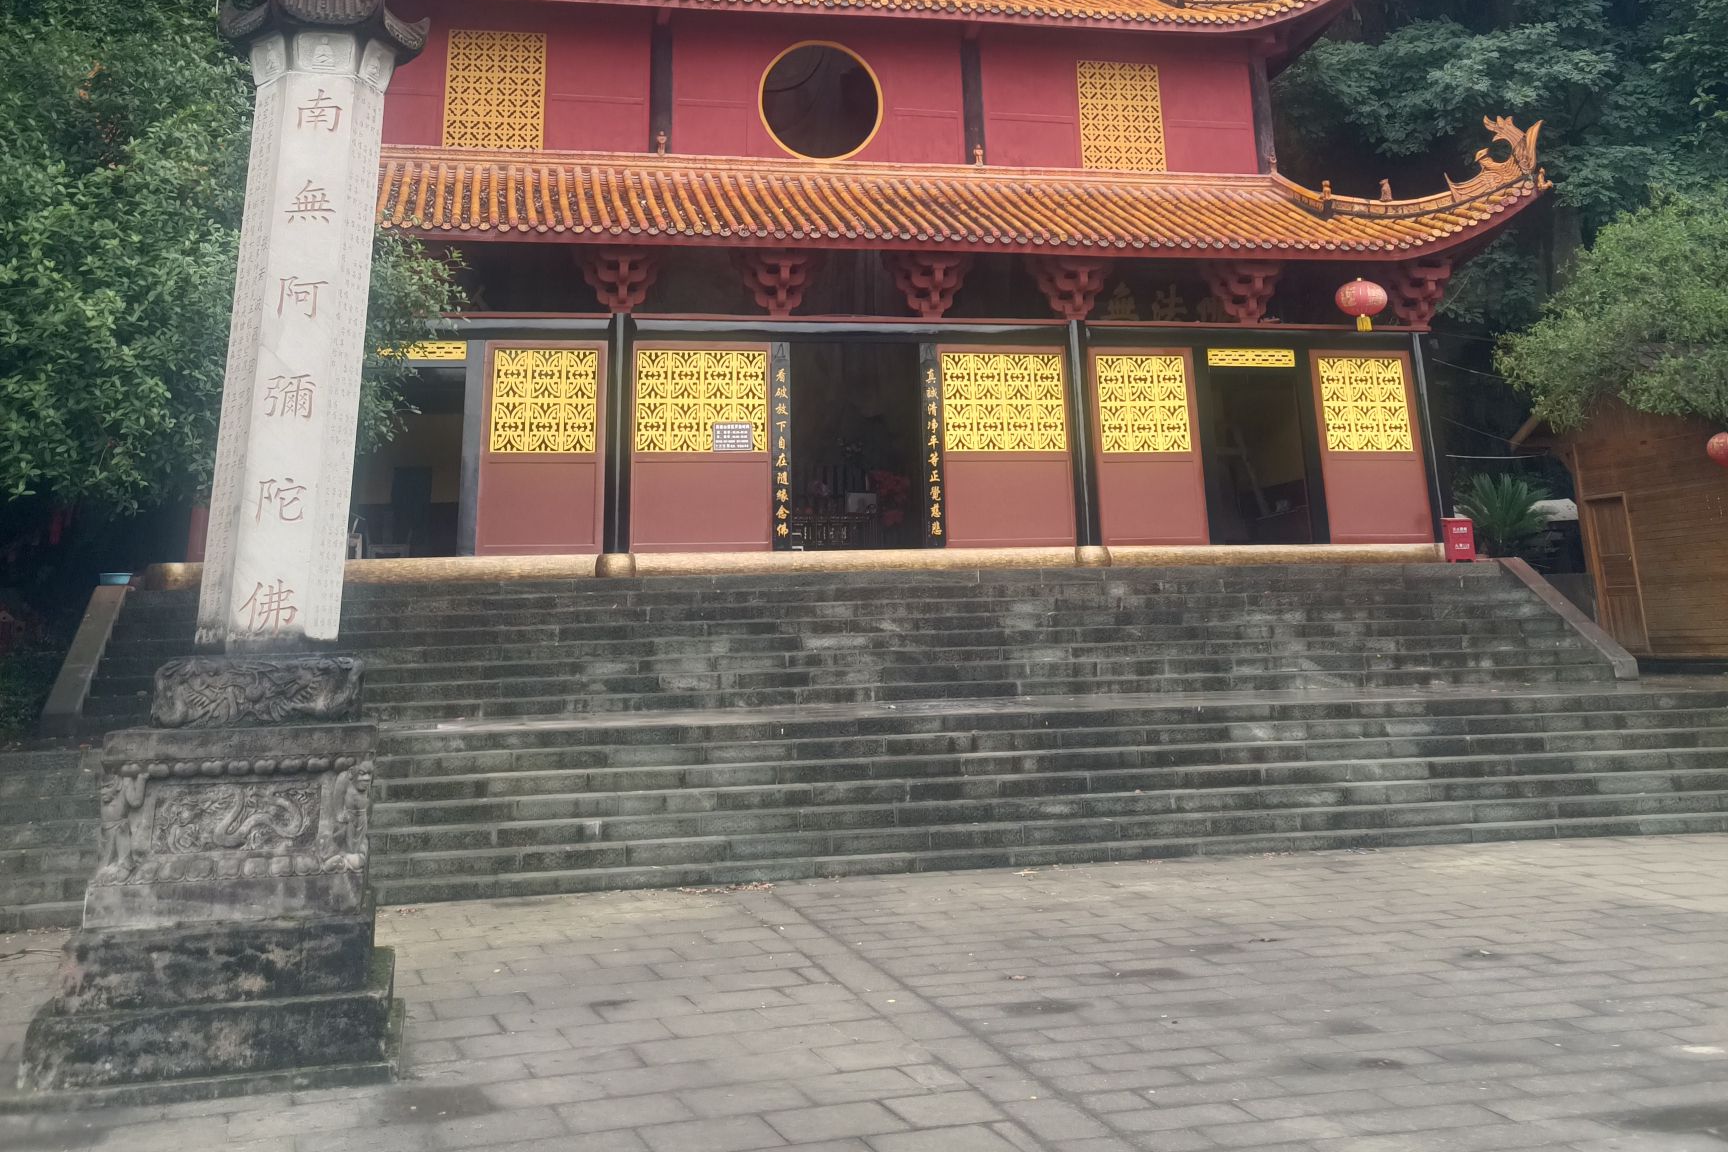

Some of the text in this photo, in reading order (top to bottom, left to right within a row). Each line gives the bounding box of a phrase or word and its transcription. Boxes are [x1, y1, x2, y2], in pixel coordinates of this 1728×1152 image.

[239, 88, 343, 634] 南無阿彌陀佛
[775, 367, 790, 538] 看破放下自在隨緣念佛
